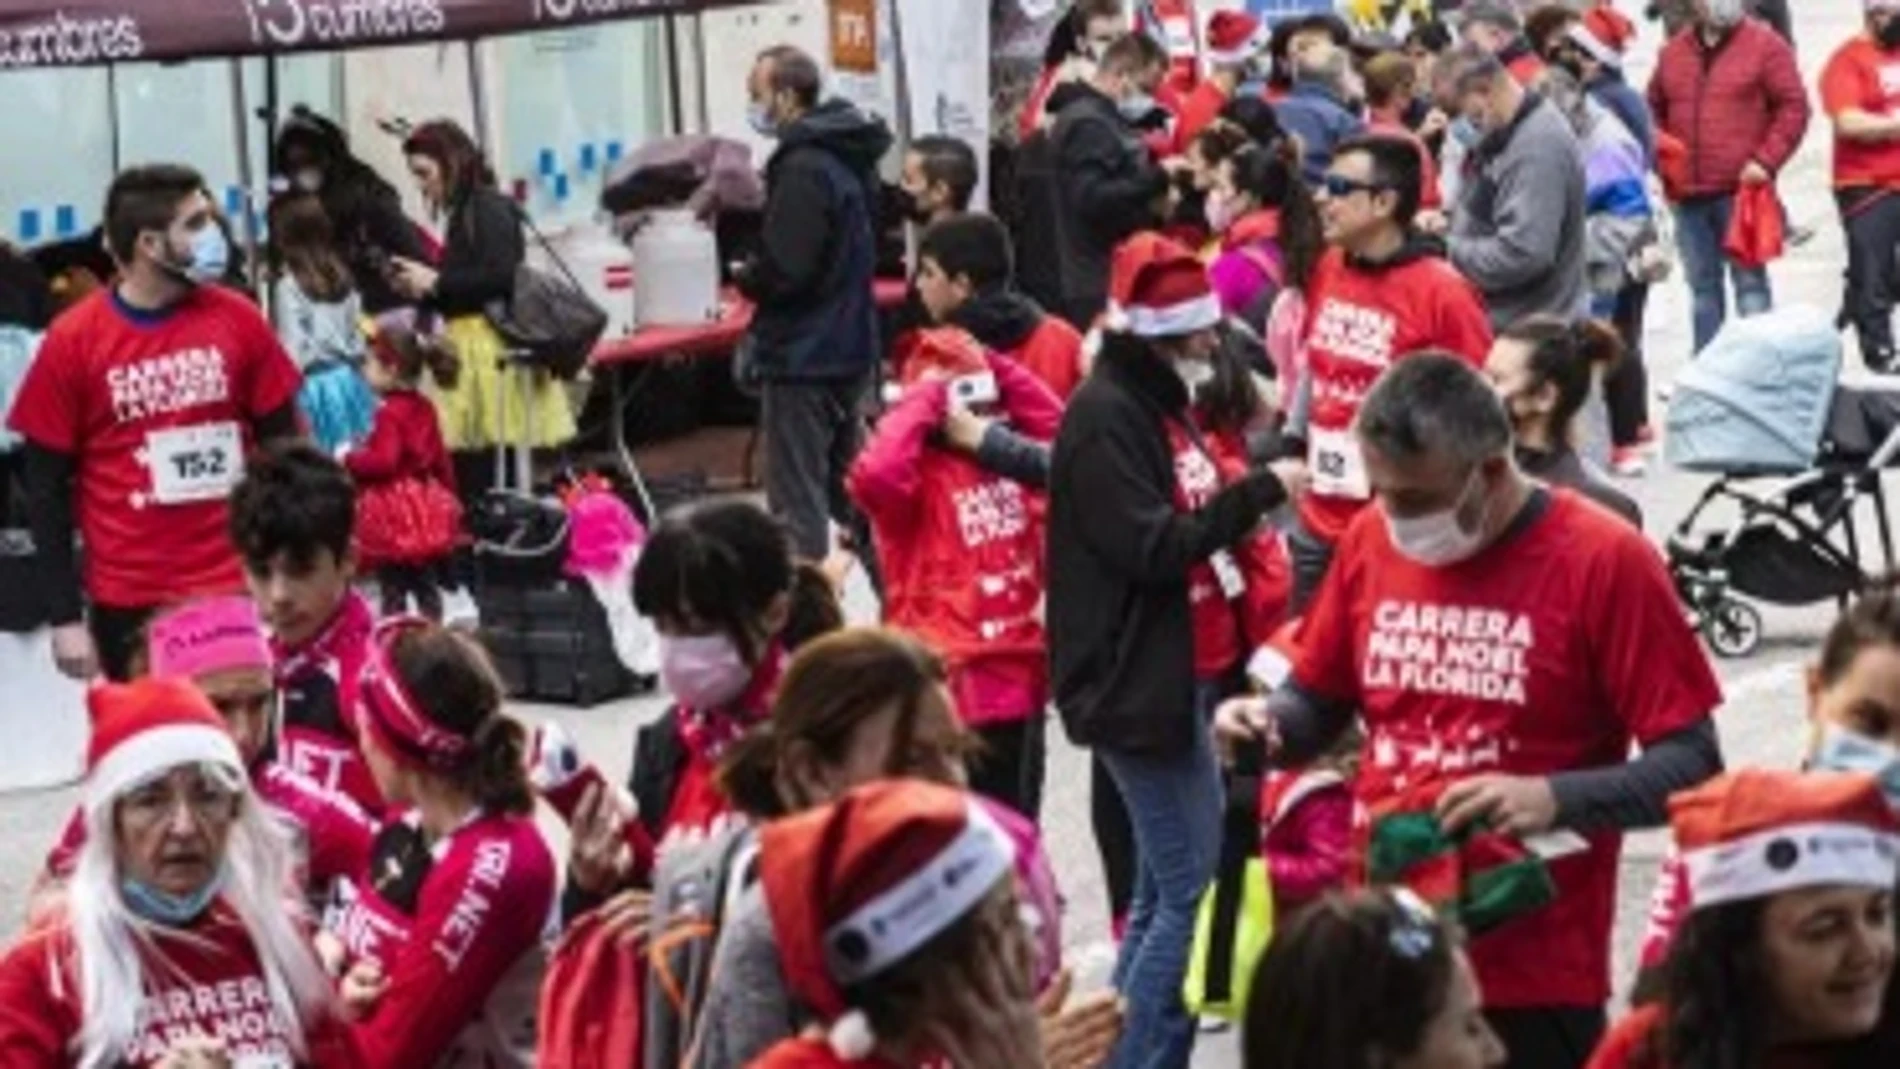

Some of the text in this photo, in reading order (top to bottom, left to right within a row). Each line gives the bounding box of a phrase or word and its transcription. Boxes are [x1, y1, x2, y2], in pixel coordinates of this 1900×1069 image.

[1374, 600, 1533, 648] CARRERA
[1368, 630, 1530, 676] PAPA NOEL
[1363, 657, 1527, 706] LA FLORIDA
